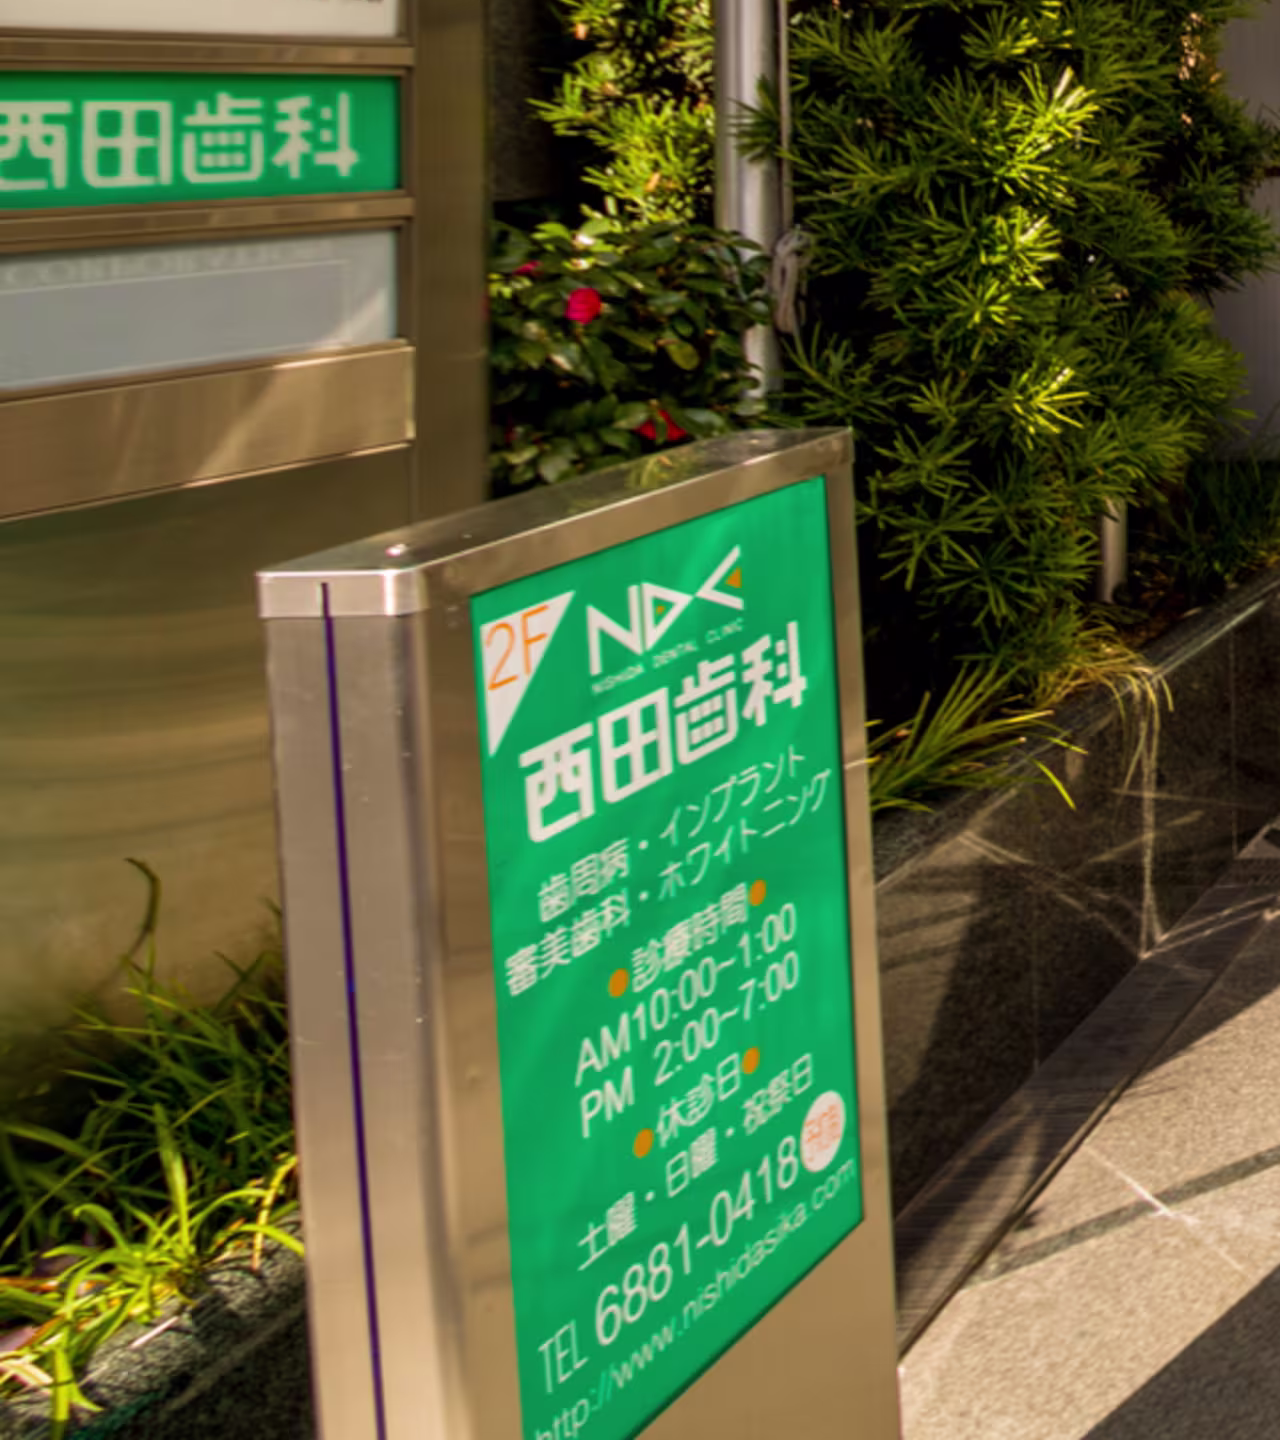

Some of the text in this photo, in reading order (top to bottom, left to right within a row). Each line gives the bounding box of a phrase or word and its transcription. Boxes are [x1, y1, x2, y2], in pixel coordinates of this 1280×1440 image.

[0, 91, 360, 192] 西田歯科
[485, 603, 550, 692] 2F
[518, 620, 808, 843] 西田歯科
[632, 881, 749, 993] 診療時間
[580, 1065, 635, 1139] PM
[656, 1052, 740, 1148] 休診日
[537, 1134, 799, 1394] TEL 6881-0418
